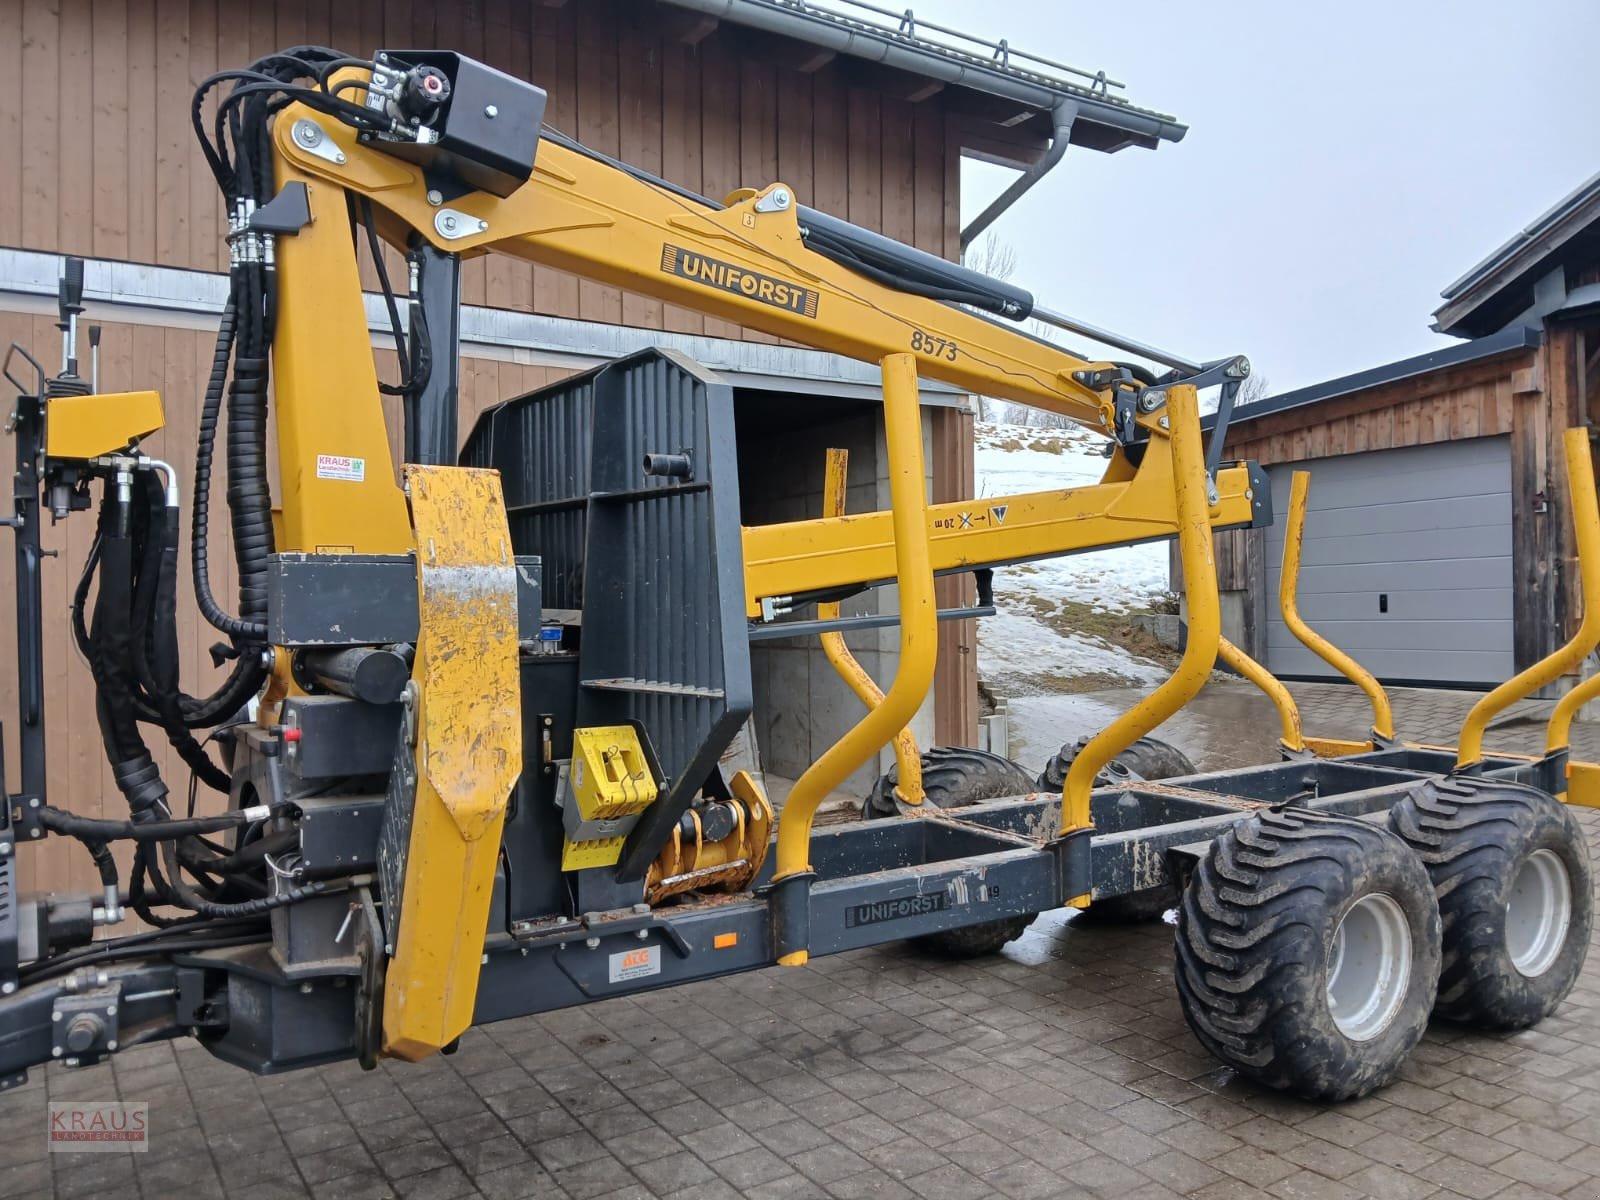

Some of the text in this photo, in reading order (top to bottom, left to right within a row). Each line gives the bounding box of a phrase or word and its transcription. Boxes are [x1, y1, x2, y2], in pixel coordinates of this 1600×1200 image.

[682, 254, 803, 309] UNIFORST
[911, 331, 957, 362] 8573
[319, 456, 351, 467] KRAUS
[859, 894, 941, 923] UNIFORST
